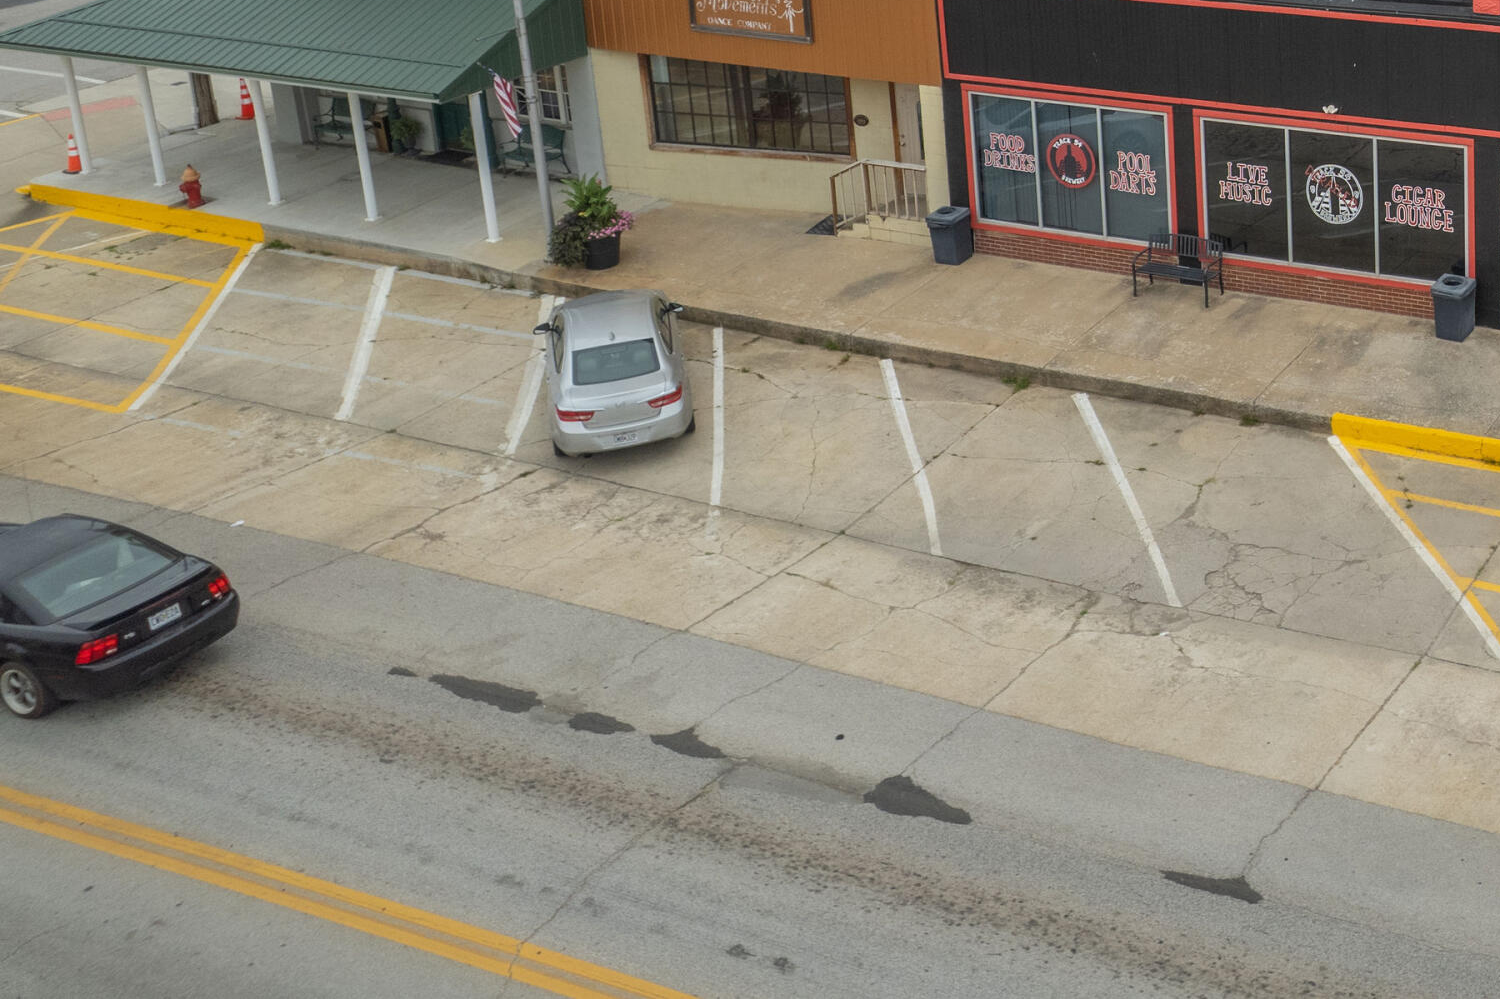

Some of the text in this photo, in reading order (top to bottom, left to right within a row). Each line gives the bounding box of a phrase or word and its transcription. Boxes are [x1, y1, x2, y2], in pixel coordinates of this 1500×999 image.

[708, 16, 772, 30] DANCE COMPANY
[989, 132, 1025, 152] FOOD
[984, 149, 1036, 173] DRINKS
[1117, 151, 1156, 176] POOL
[1227, 161, 1269, 186] LIVE
[1110, 170, 1157, 196] DARTS
[1219, 180, 1272, 206] MUSIC
[1391, 184, 1446, 209] CIGAR
[1384, 201, 1454, 233] LOUNGE
